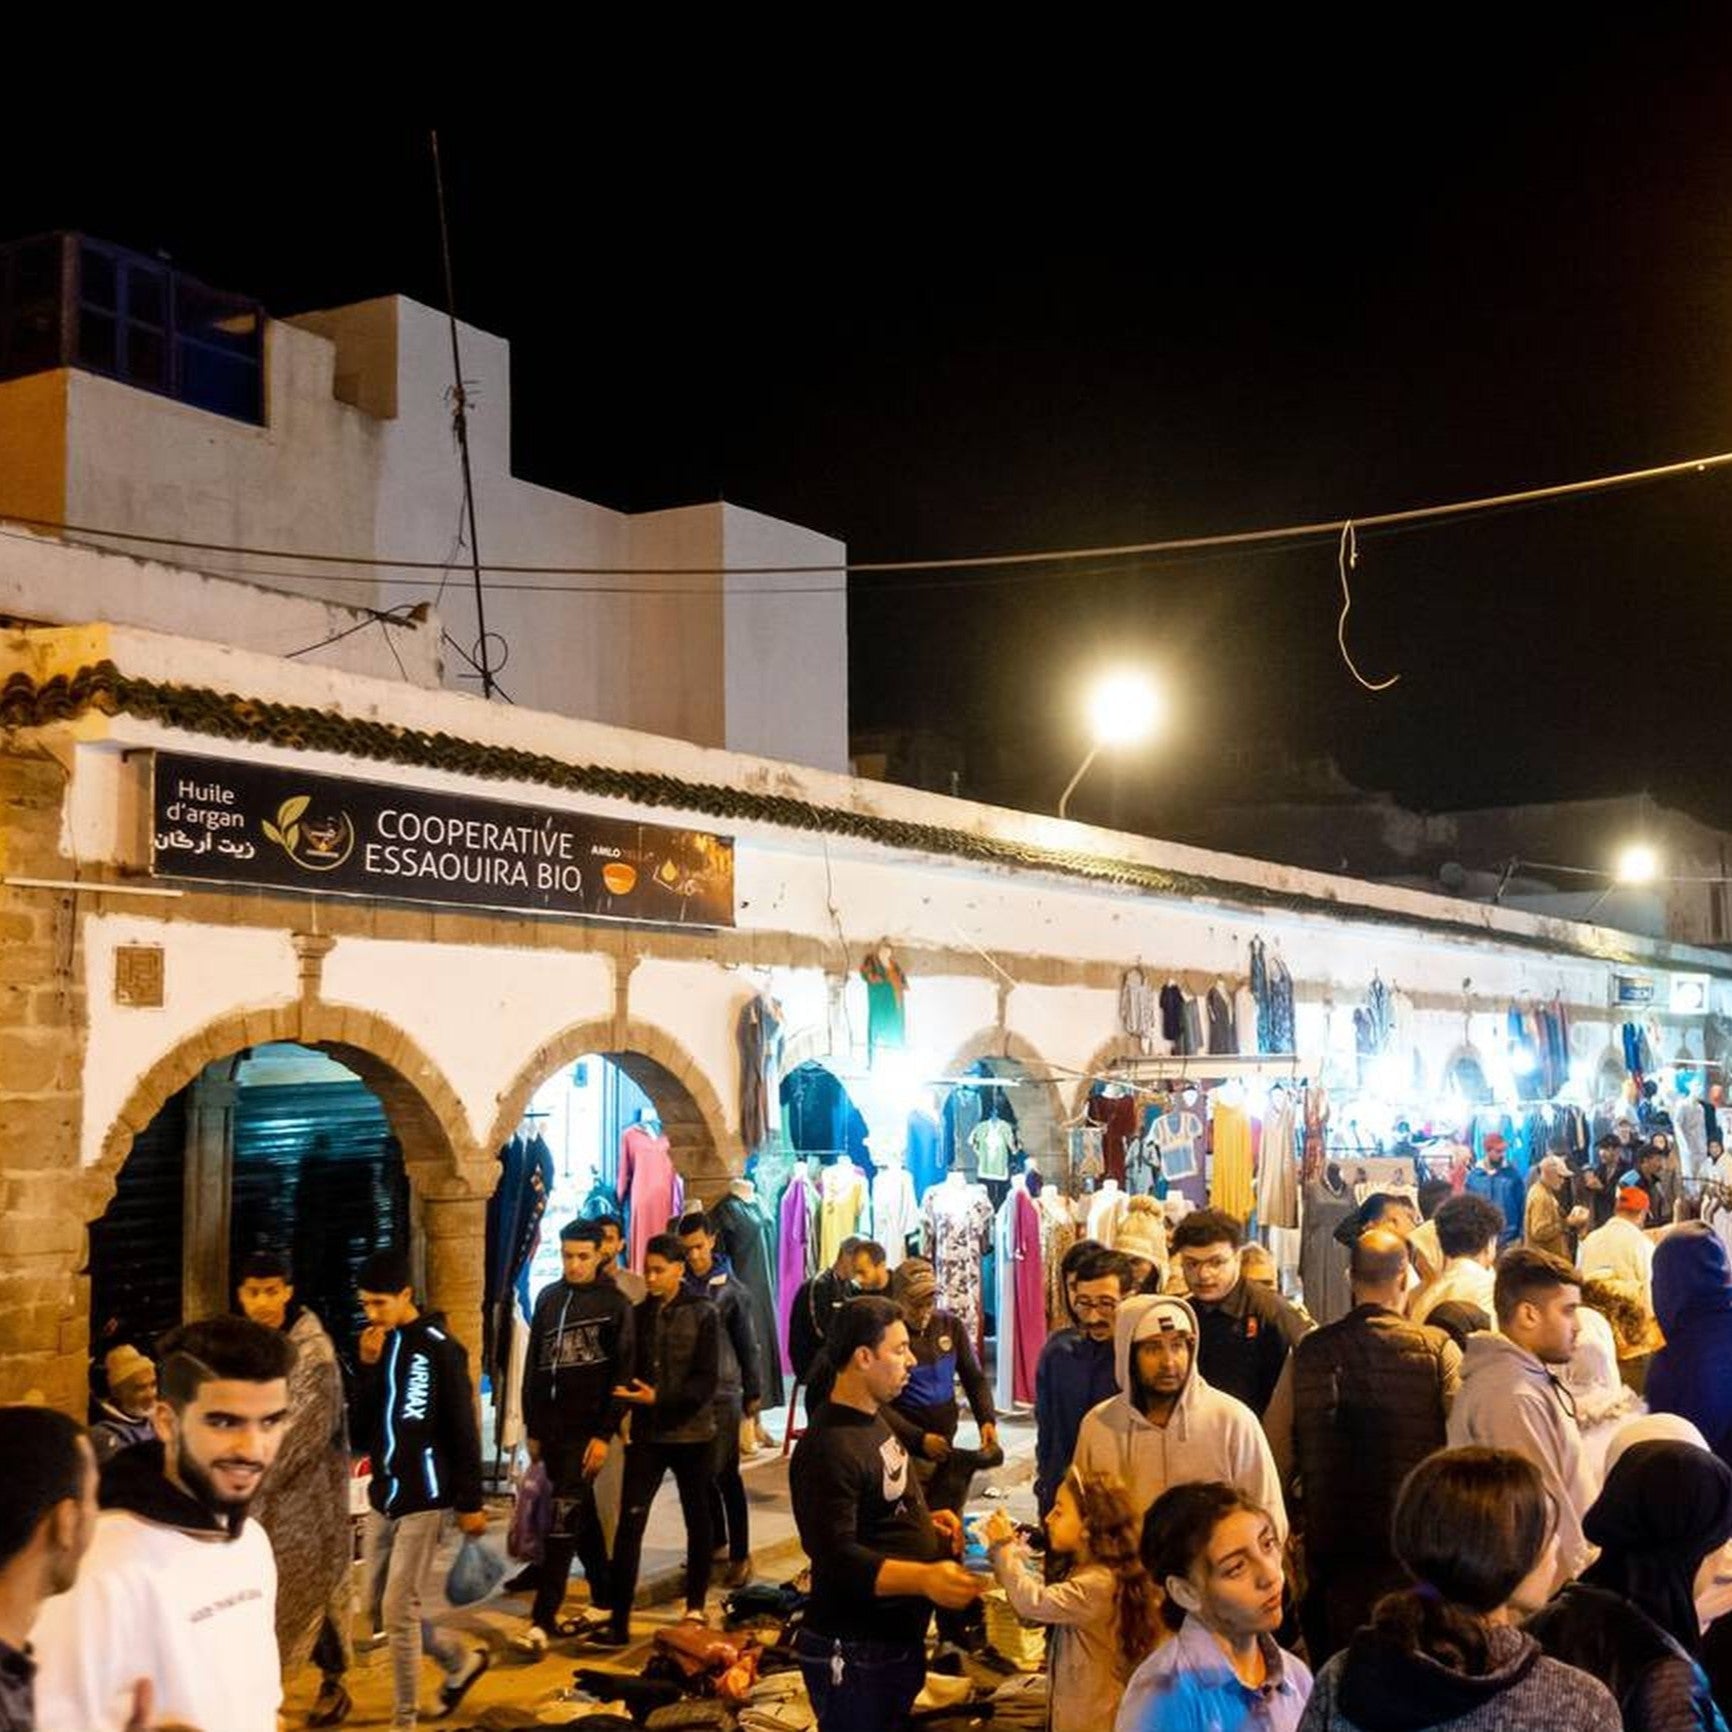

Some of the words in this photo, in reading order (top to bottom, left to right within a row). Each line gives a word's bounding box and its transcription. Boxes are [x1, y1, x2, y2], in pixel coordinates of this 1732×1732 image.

[178, 779, 235, 806] Huile
[166, 801, 245, 831] d'argan
[377, 809, 575, 861] COOPERATIVE
[217, 838, 256, 860] زيت
[365, 843, 529, 888] ESSAOUIRA
[537, 862, 582, 893] BIO
[402, 1352, 430, 1420] AIRMAX
